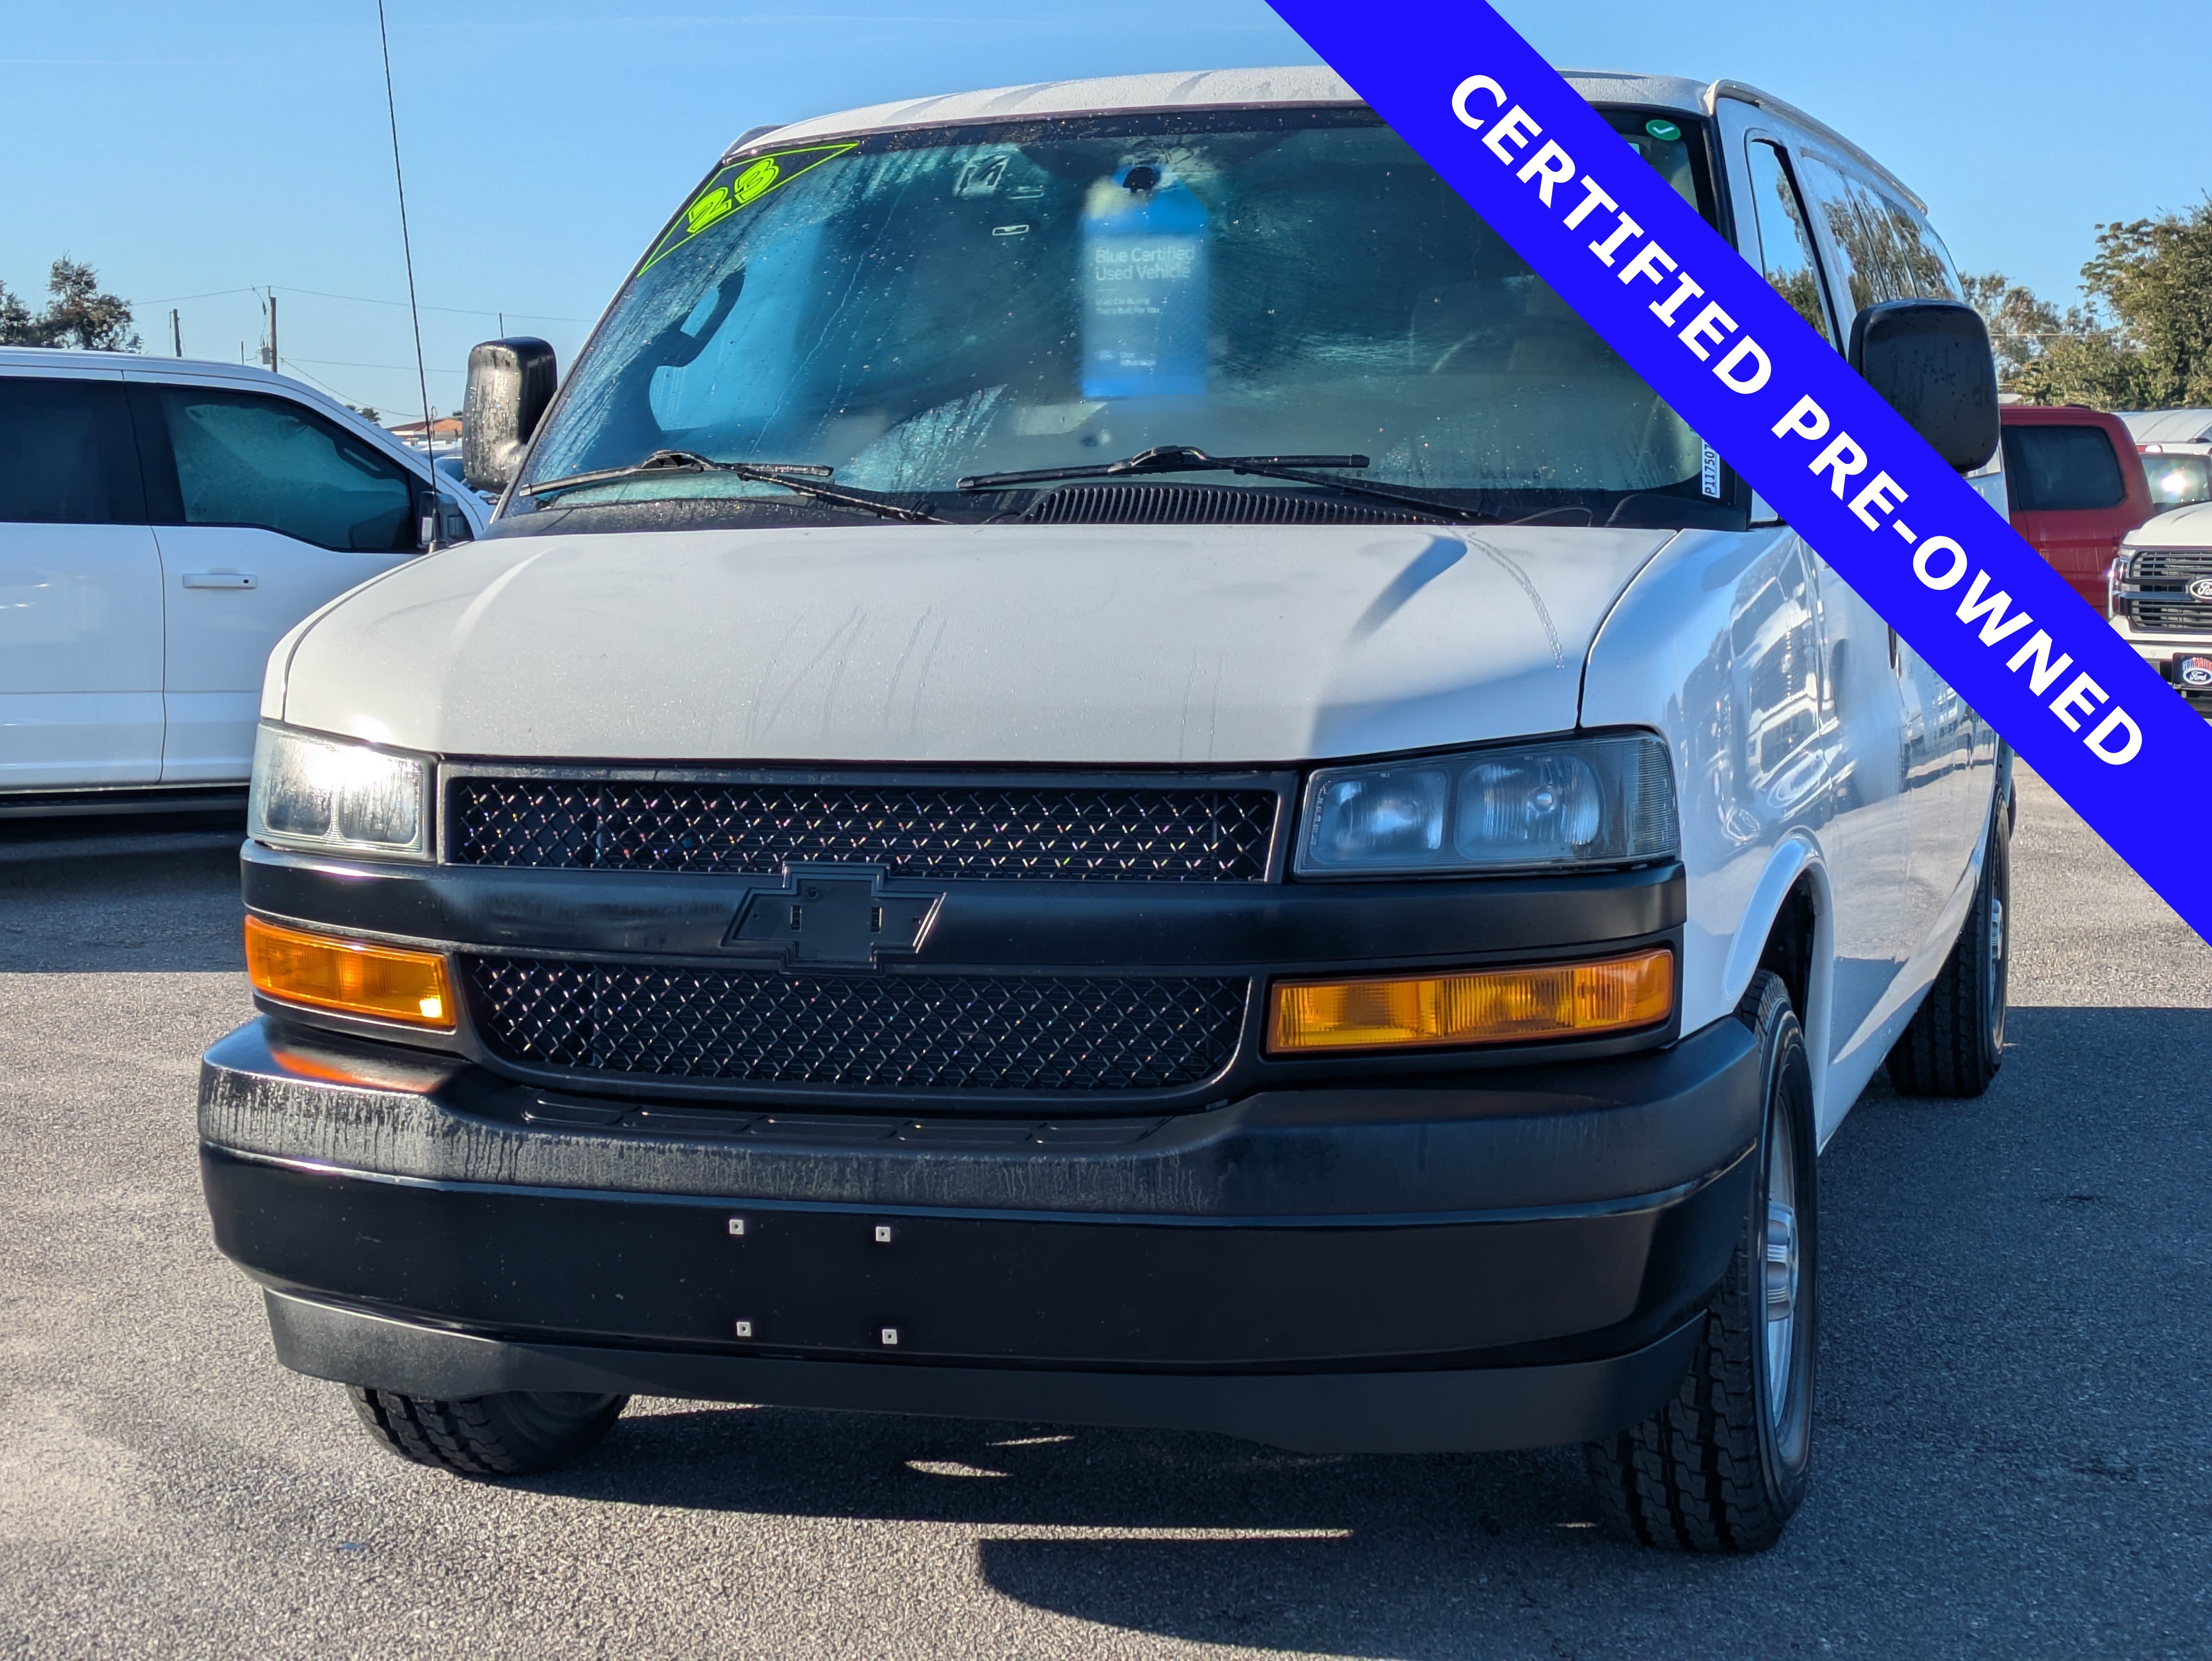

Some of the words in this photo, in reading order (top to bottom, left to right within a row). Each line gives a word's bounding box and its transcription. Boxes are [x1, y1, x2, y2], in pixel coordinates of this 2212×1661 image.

[687, 158, 780, 233] 23
[1095, 248, 1128, 263] Blue
[1131, 246, 1195, 262] Certified
[1095, 265, 1132, 280] Used
[1136, 264, 1190, 279] Vehicle
